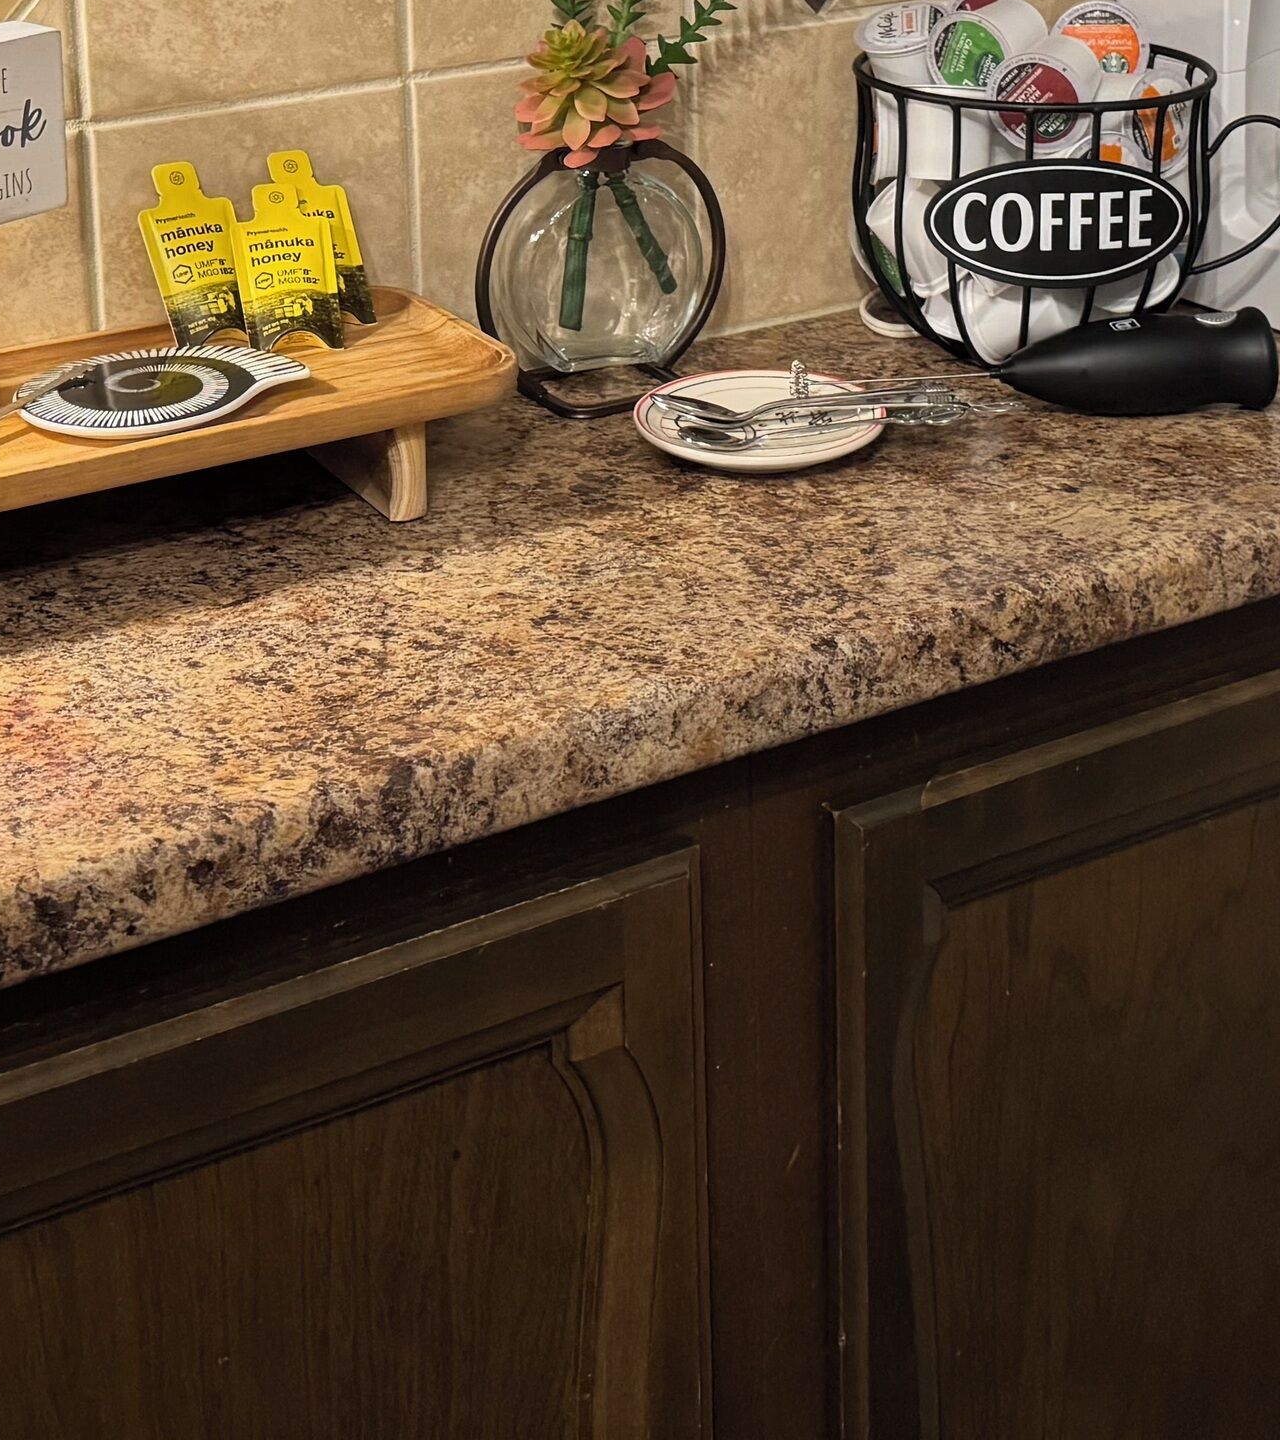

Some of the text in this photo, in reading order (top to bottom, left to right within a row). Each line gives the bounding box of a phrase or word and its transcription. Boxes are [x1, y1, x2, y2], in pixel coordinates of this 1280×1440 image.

[955, 38, 973, 73] CARAMEL
[952, 188, 1153, 253] COFFEE
[160, 223, 224, 243] mānuka
[164, 240, 214, 259] honey
[251, 252, 302, 268] honey
[197, 268, 219, 279] MGO
[278, 276, 301, 285] MGO
